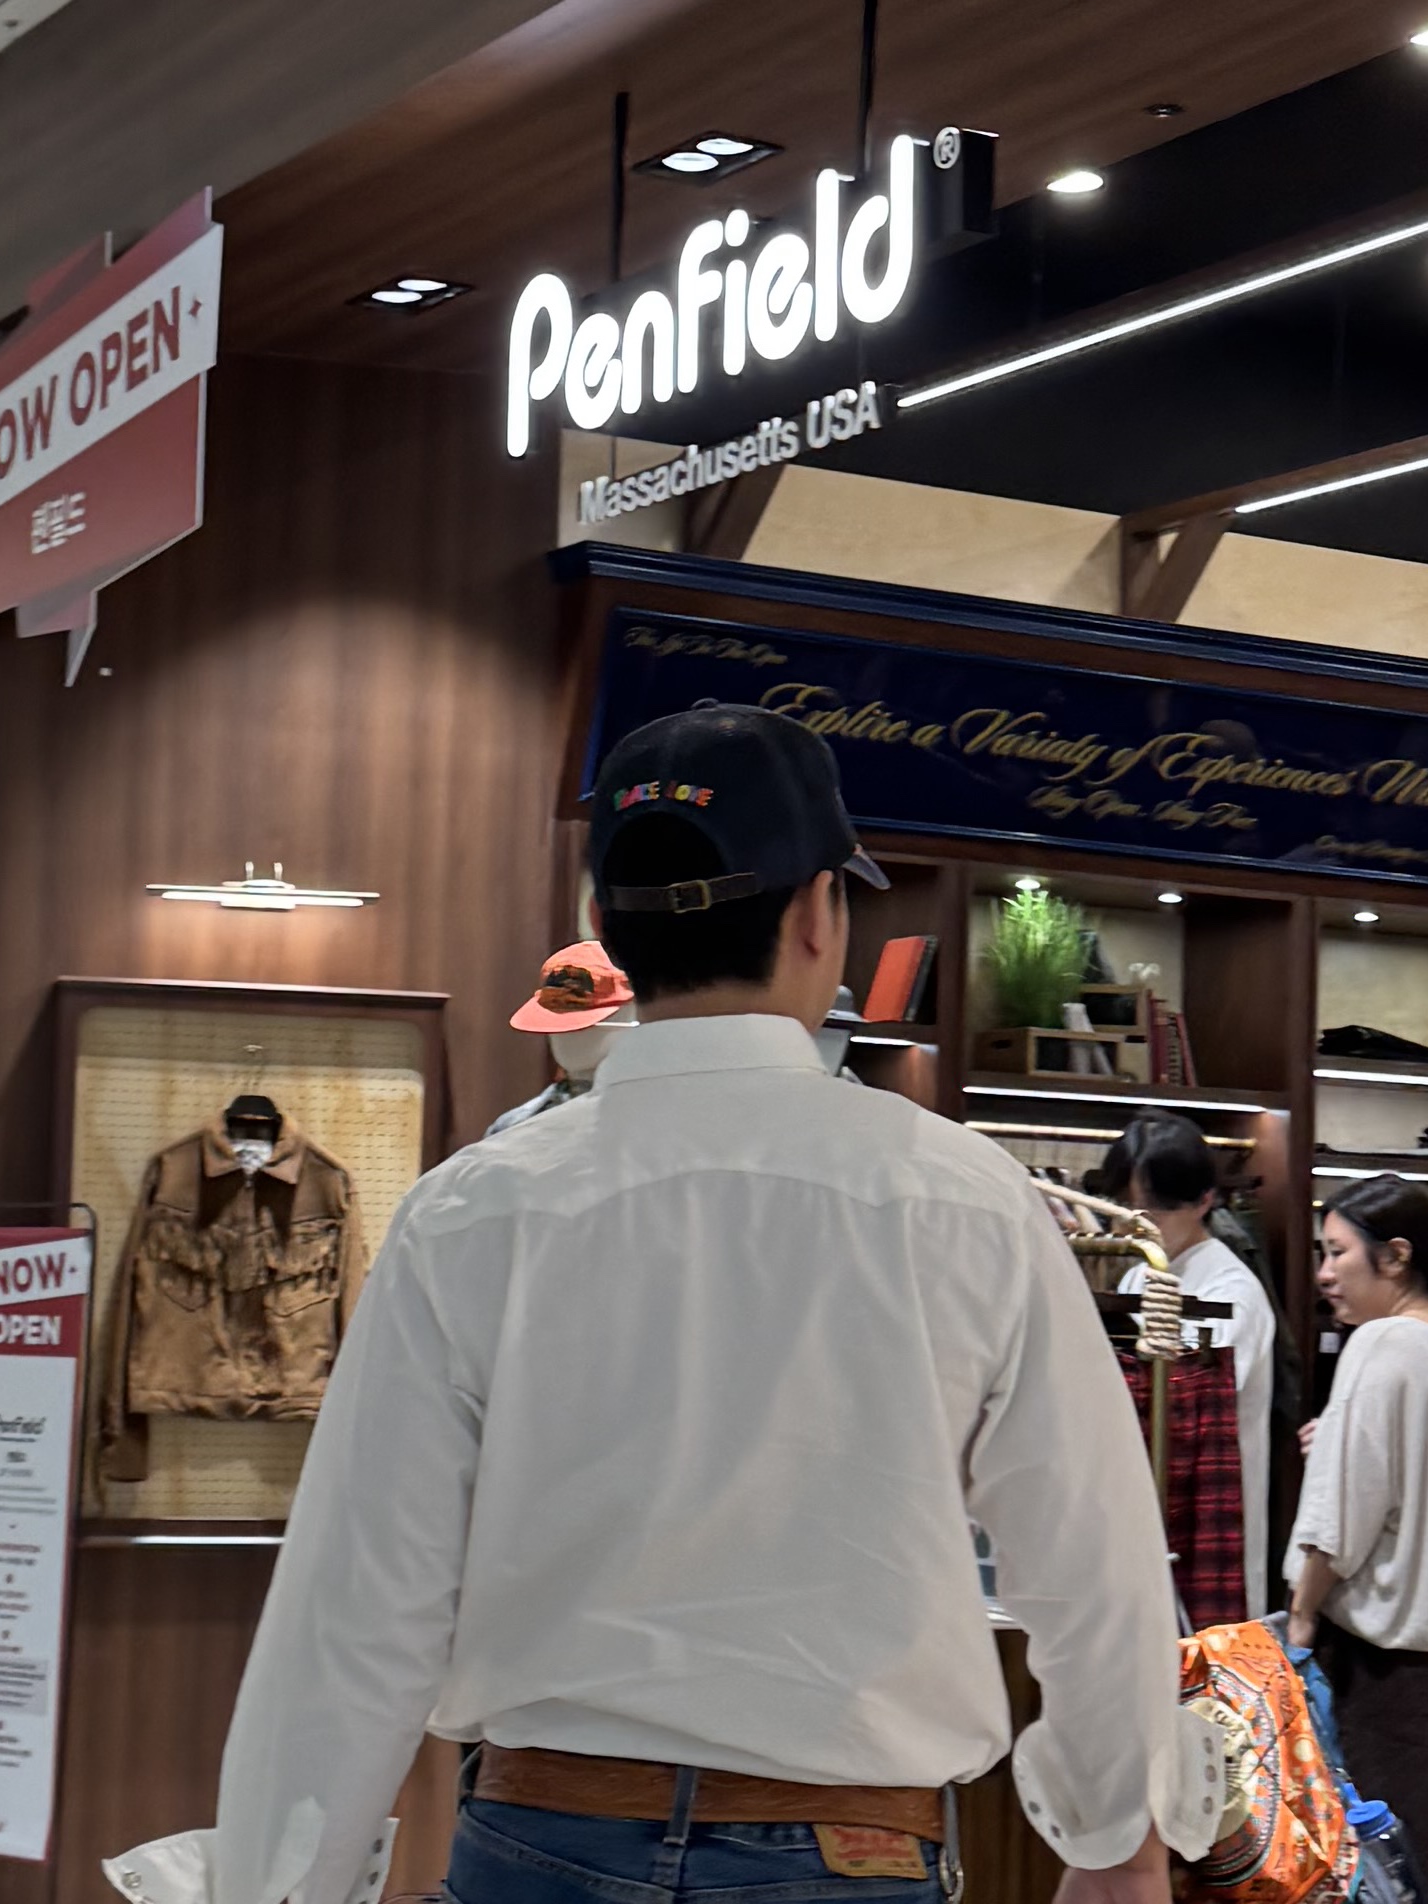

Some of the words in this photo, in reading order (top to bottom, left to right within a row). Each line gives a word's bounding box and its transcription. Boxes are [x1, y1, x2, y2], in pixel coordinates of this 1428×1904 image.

[68, 285, 181, 427] OPEN
[507, 134, 915, 458] Penfield
[577, 414, 800, 526] Massachusetts
[805, 380, 882, 449] USA
[948, 708, 1108, 782] Variety
